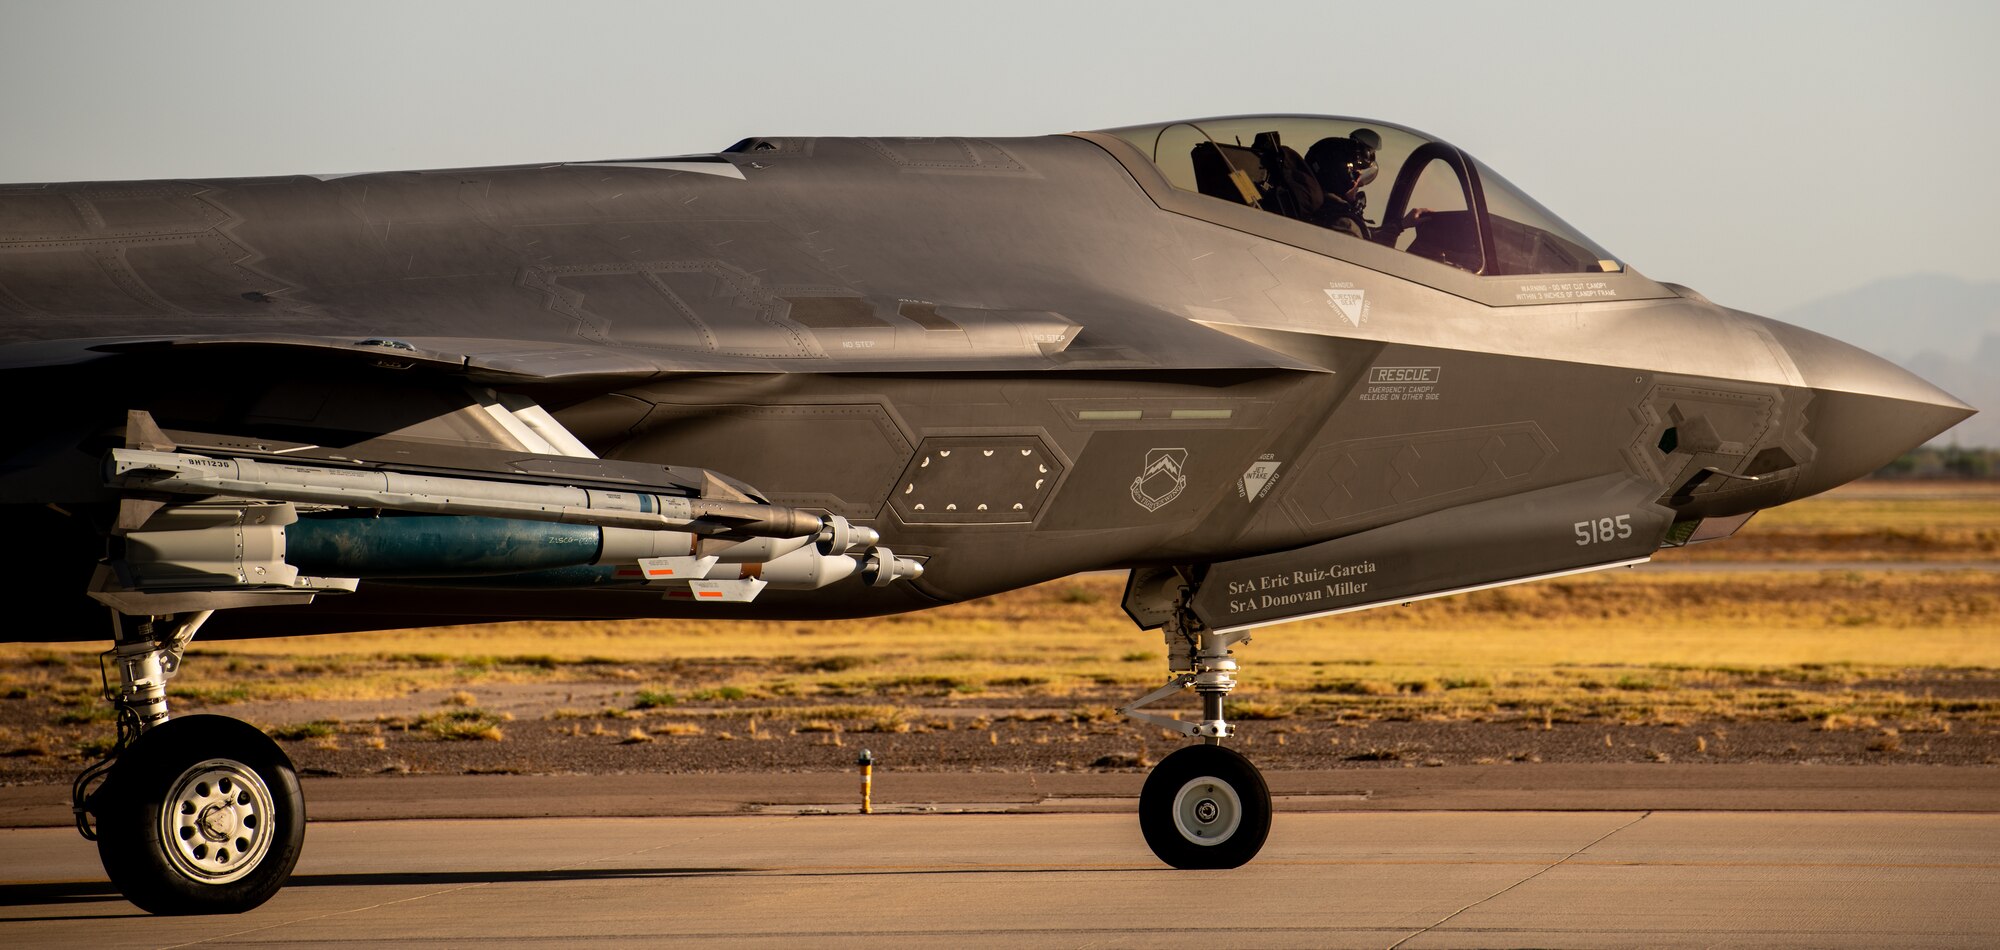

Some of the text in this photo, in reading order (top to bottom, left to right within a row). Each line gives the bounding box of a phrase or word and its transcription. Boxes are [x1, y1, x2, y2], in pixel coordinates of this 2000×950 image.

[1329, 281, 1354, 289] DANGER
[1520, 284, 1548, 292] WARNING
[1544, 291, 1565, 299] INCHES
[1575, 290, 1597, 298] CANOPY
[1597, 289, 1616, 297] FRAME
[1326, 299, 1349, 323] DANGER
[1047, 334, 1066, 342] STEP
[855, 340, 875, 348] STEP
[1378, 369, 1432, 381] RESCUE
[1368, 386, 1407, 394] EMERGENCY
[1360, 393, 1389, 401] RELEASE
[1402, 393, 1424, 401] OTHER
[1259, 472, 1280, 498] DANGER
[1574, 513, 1632, 546] 5185
[1228, 560, 1376, 595] SrA Eric Ruiz-Garcia
[1230, 581, 1368, 614] SrA Donovan Miller
